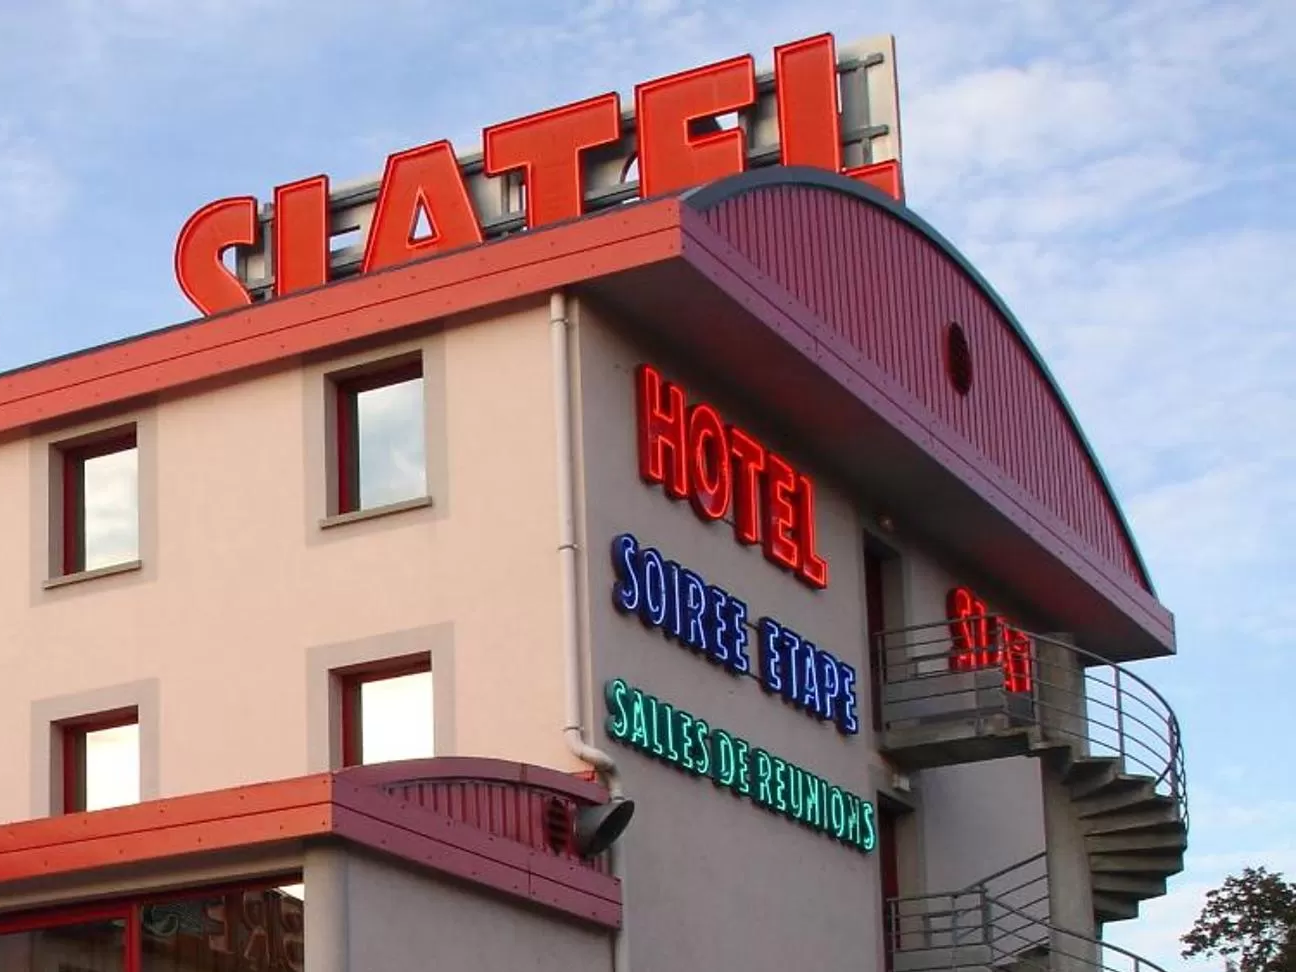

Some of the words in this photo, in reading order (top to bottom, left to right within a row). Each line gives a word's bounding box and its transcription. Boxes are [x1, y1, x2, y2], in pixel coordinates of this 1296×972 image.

[174, 32, 901, 316] SIATEL
[636, 363, 827, 589] HOTEL
[612, 533, 749, 675] SOIREE
[758, 616, 859, 735] ETAPE
[607, 678, 710, 775] SALLES
[711, 729, 750, 795] DE
[751, 747, 878, 853] REUNIONS
